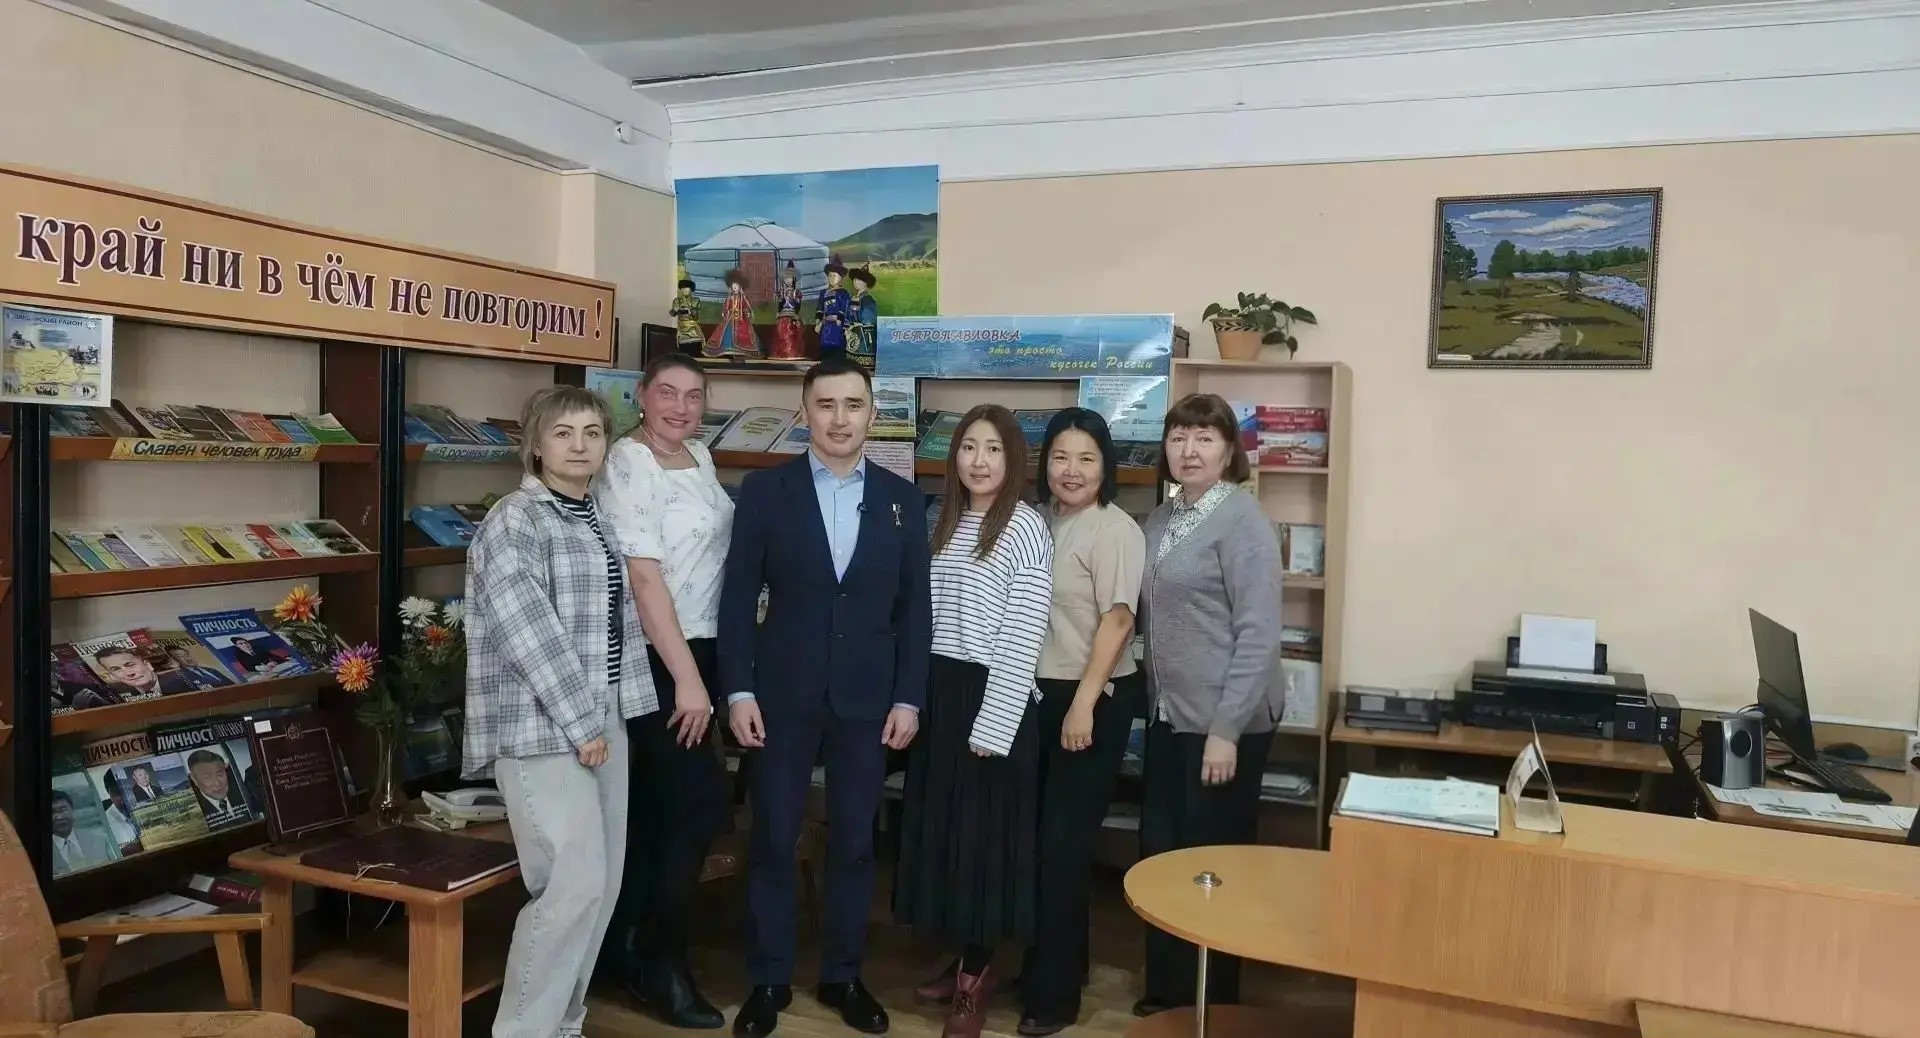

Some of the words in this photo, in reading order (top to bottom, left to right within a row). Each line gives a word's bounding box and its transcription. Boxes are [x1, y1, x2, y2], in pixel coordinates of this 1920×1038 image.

[16, 212, 166, 286] край
[180, 240, 244, 291] ни
[257, 255, 284, 296] в
[295, 252, 377, 312] чём
[388, 276, 433, 318] не
[441, 285, 587, 345] повторим
[891, 328, 1021, 342] ПЕТРОПАВЛОВКА
[988, 345, 1010, 355] это
[1017, 344, 1063, 356] просто
[1050, 359, 1098, 372] кусочек
[1105, 356, 1153, 369] России
[133, 440, 197, 456] Славен
[200, 445, 262, 458] человек
[263, 445, 302, 459] труда
[192, 618, 258, 633] ЛИЧНОСТЬ
[156, 729, 214, 750] ЛИЧНОСТ
